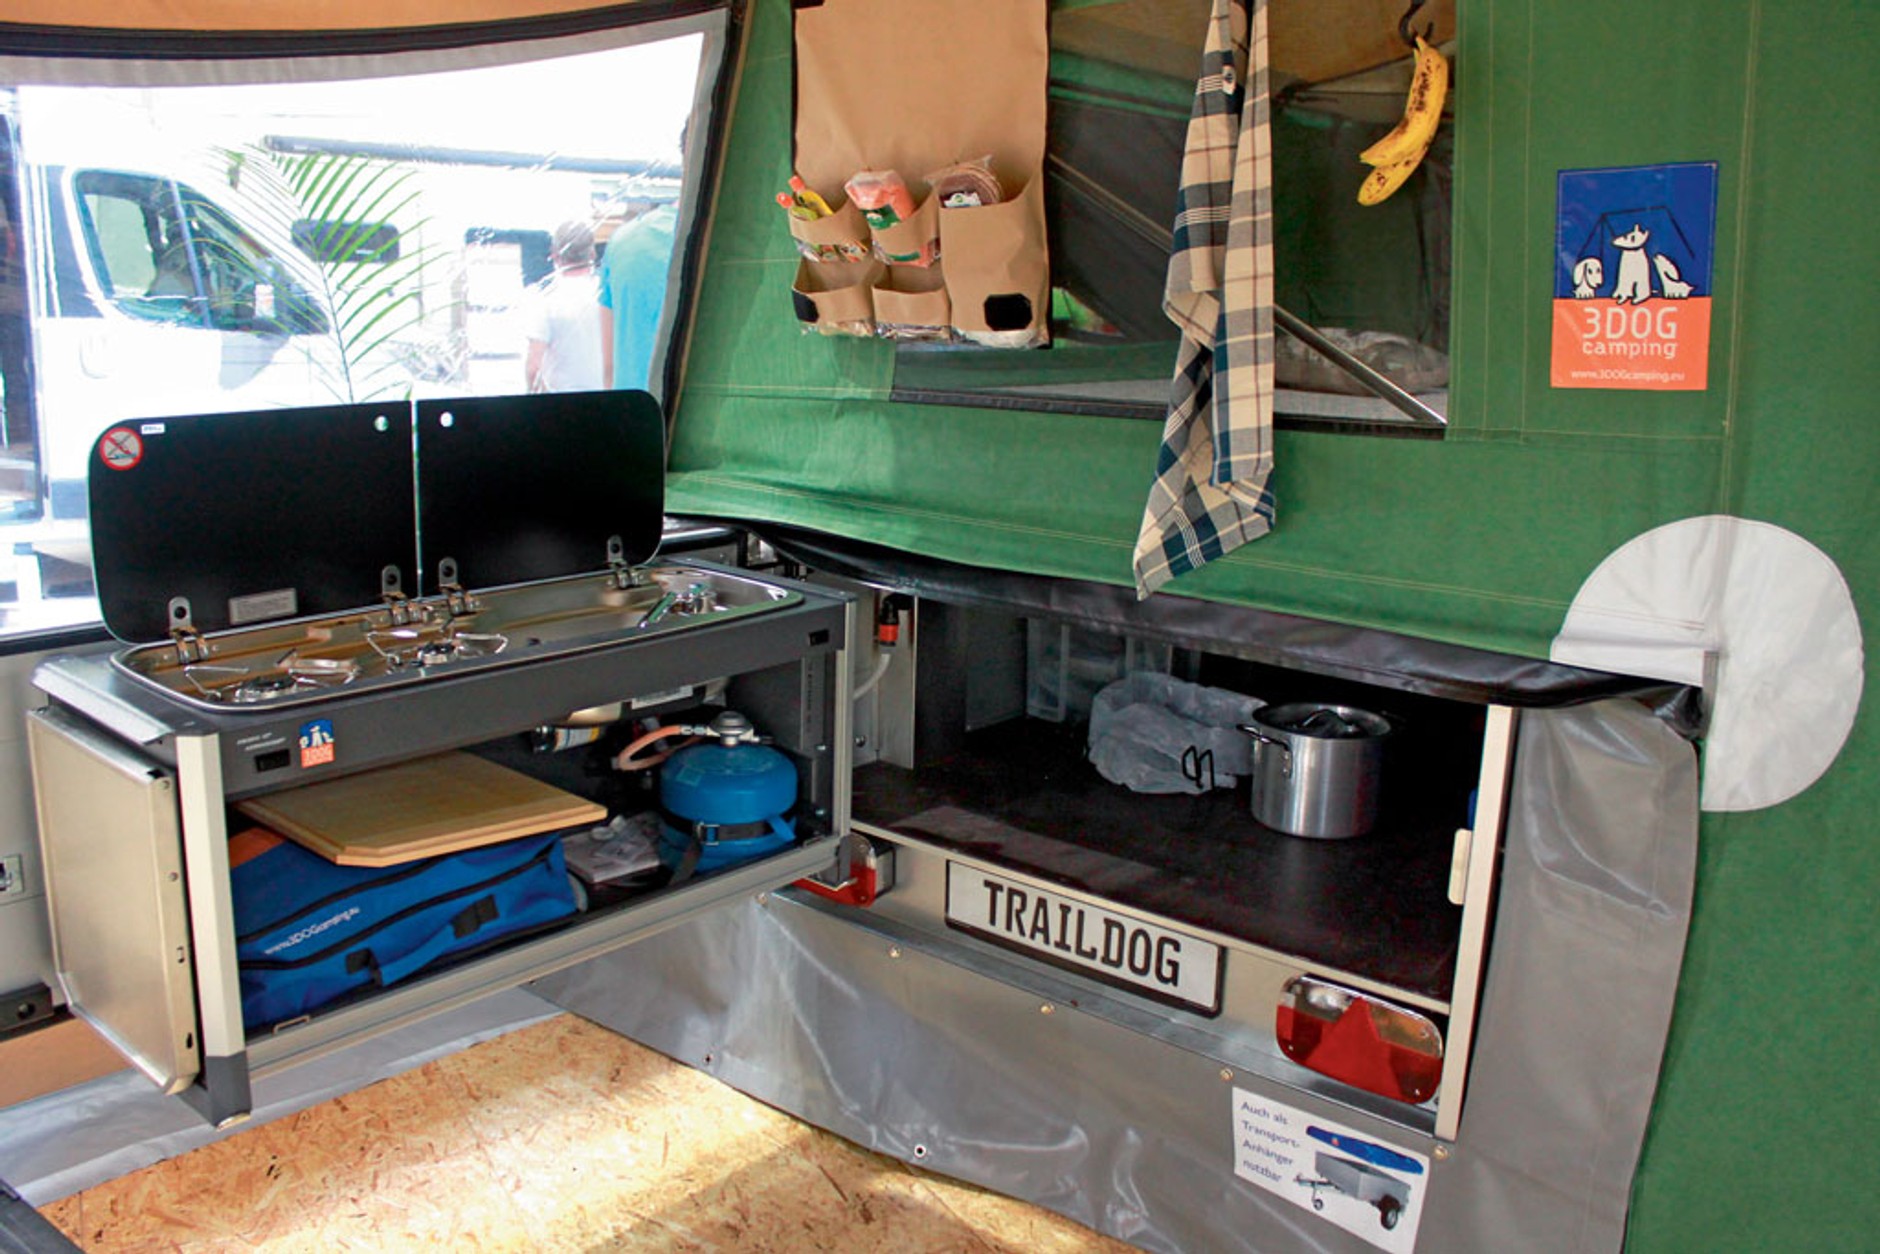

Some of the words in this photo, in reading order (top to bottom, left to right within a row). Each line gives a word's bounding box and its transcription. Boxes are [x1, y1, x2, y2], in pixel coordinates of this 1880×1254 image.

[1582, 306, 1678, 340] 3DOG
[1582, 340, 1678, 359] camping
[983, 879, 1182, 987] TRAILDOG
[1241, 1101, 1270, 1119] Auch
[1273, 1112, 1289, 1125] als
